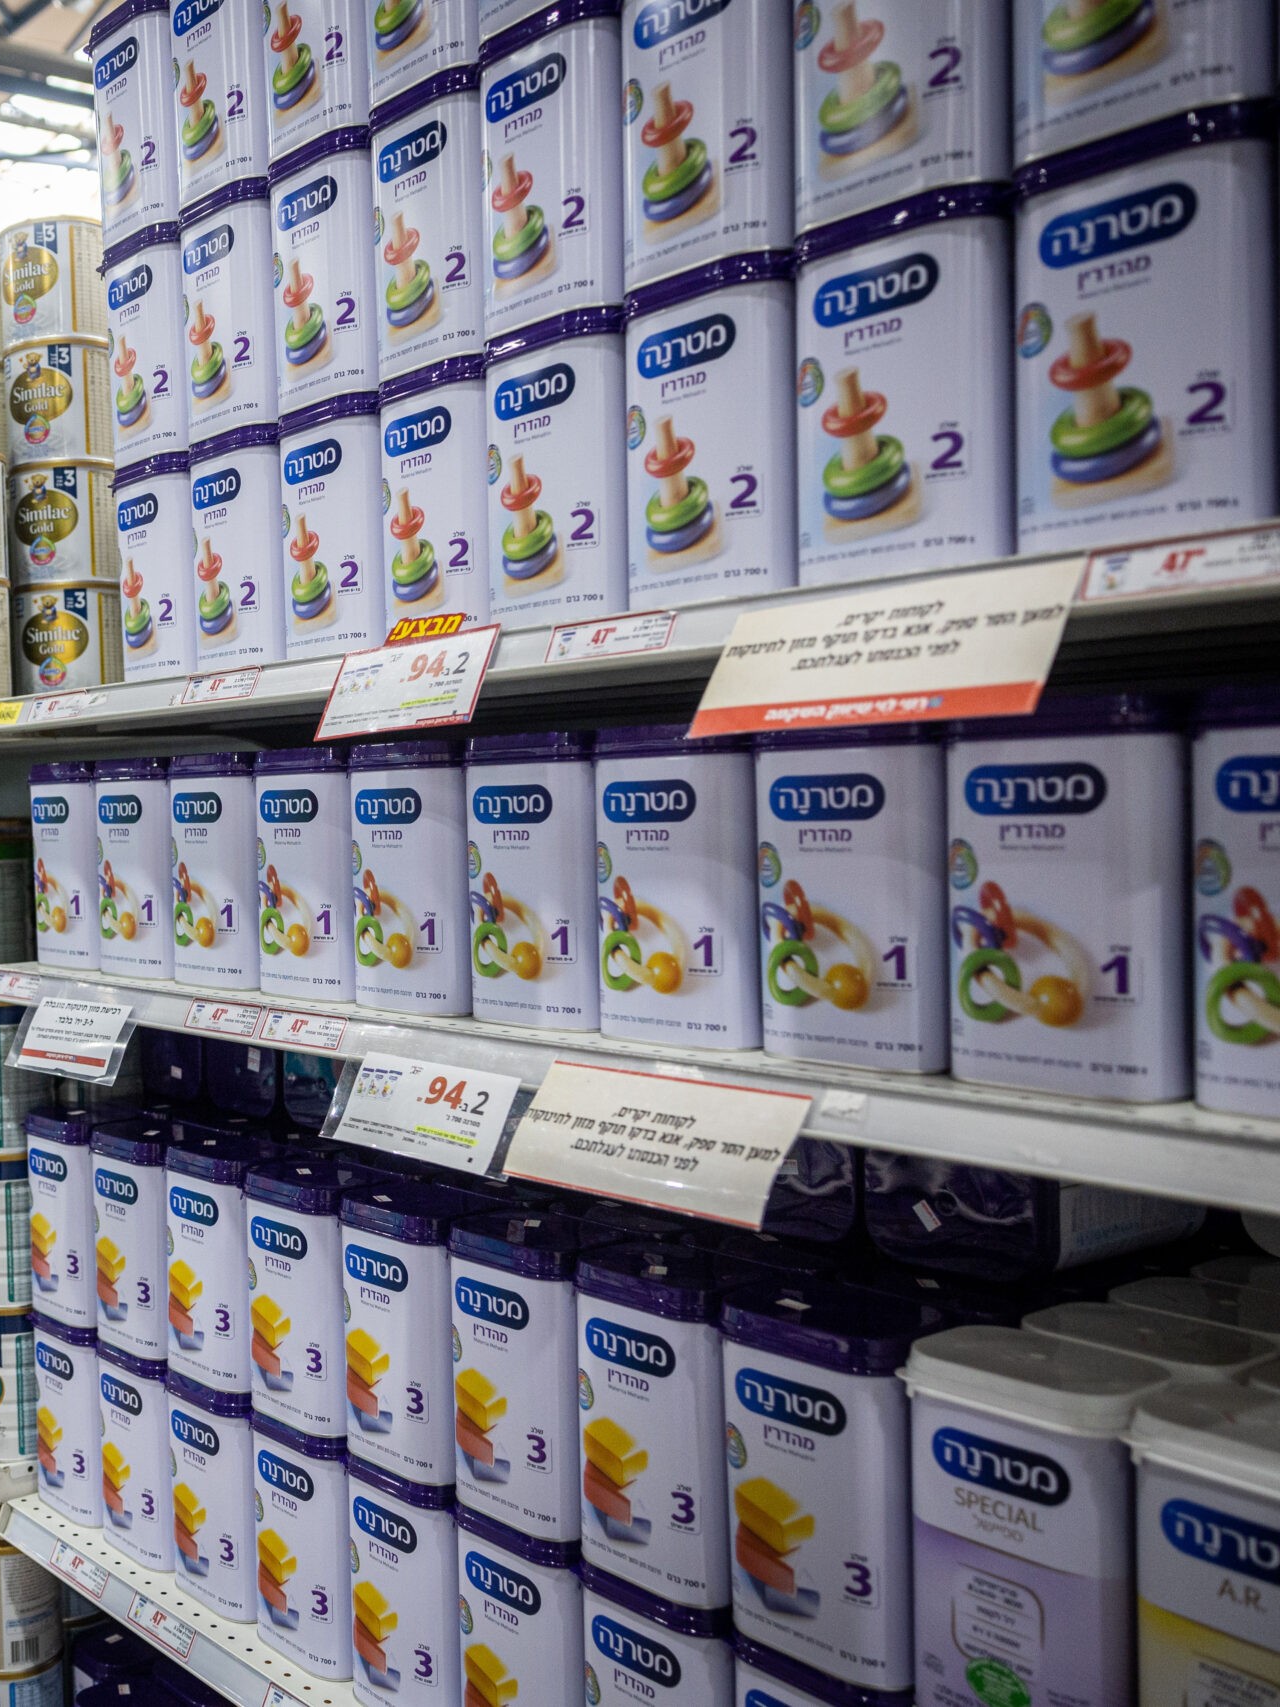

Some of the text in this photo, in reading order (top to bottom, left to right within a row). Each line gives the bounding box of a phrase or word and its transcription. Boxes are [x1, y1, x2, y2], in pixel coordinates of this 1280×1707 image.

[928, 46, 962, 88] 2
[141, 141, 156, 166] 2
[562, 195, 585, 229] 2
[45, 225, 55, 241] 3
[336, 297, 355, 325] 2
[58, 348, 69, 363] 3
[13, 383, 66, 404] Similac
[1187, 381, 1226, 426] 2
[24, 401, 48, 413] Gold
[931, 431, 964, 470] 2
[64, 469, 75, 487] 3
[730, 474, 757, 509] 2
[19, 503, 70, 523] Similac
[570, 508, 594, 541] 2
[29, 521, 54, 533] Gold
[449, 538, 469, 567] 2
[74, 591, 85, 608] 3
[26, 627, 80, 643] Similac
[389, 614, 463, 641] מבצע!
[39, 642, 65, 654] Gold
[453, 651, 470, 675] 2
[220, 904, 233, 928] 1
[420, 918, 435, 945] 1
[551, 926, 569, 955] 1
[883, 945, 906, 980] 1
[470, 1091, 490, 1116] 2
[215, 1309, 230, 1332] 3
[406, 1387, 424, 1414] 3
[671, 1492, 695, 1524] 3
[954, 1487, 1043, 1532] SPECIAL
[311, 1590, 328, 1615] 3
